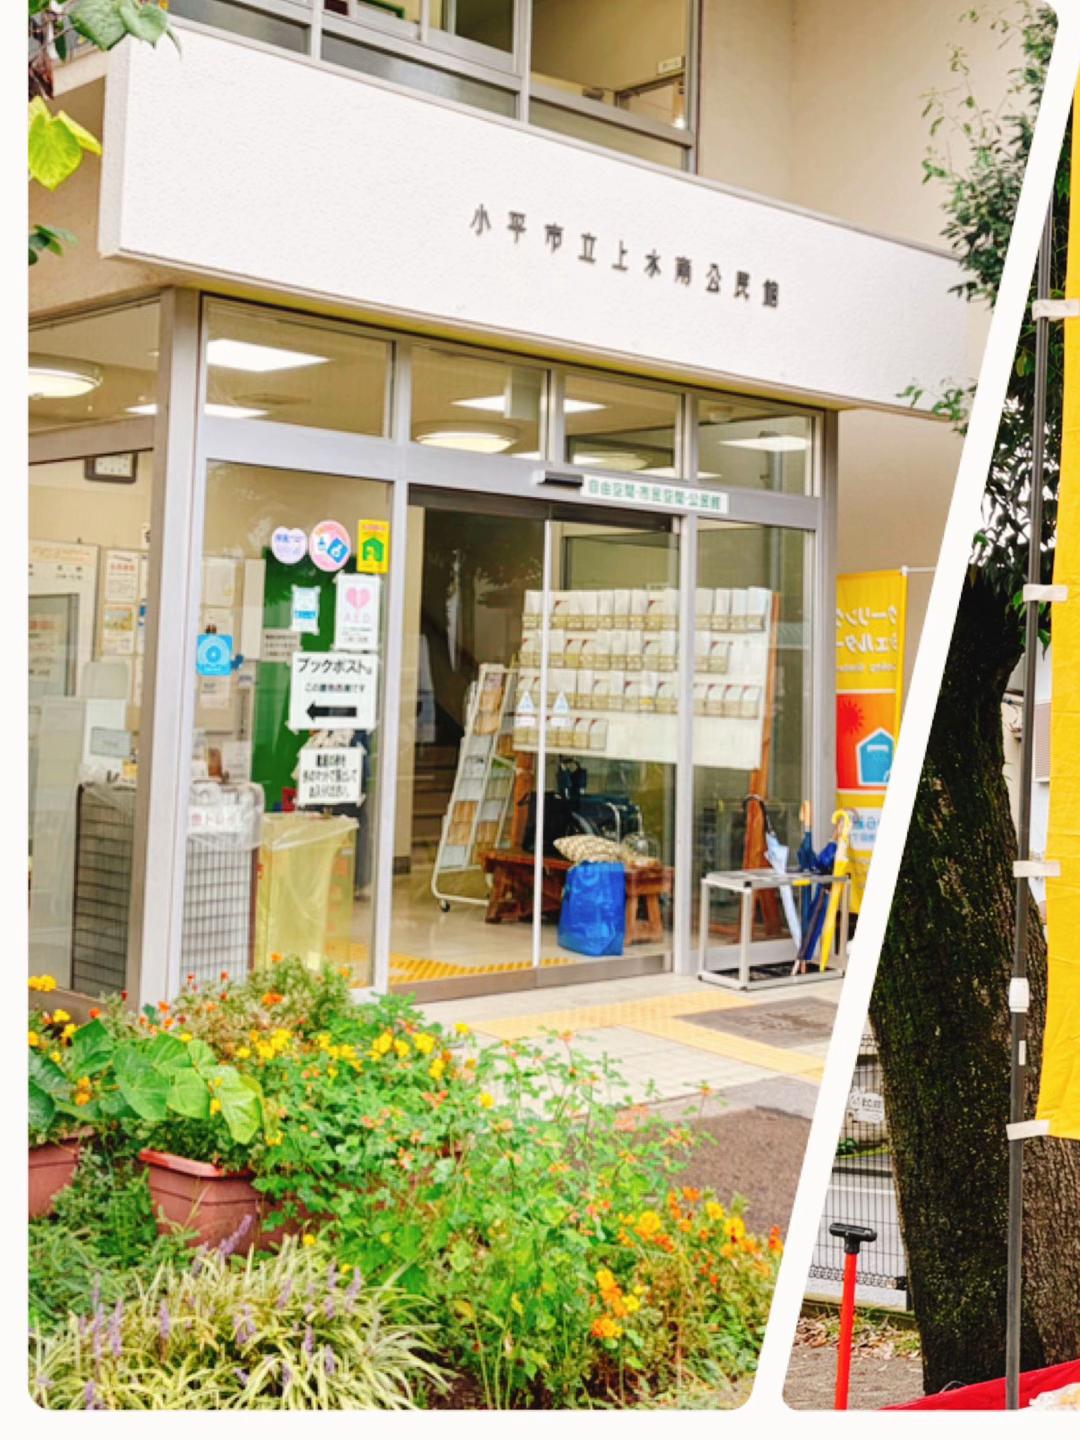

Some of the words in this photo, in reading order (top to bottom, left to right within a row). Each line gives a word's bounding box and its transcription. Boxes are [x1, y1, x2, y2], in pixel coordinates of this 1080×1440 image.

[470, 203, 779, 309] 小平市立上水南公民館
